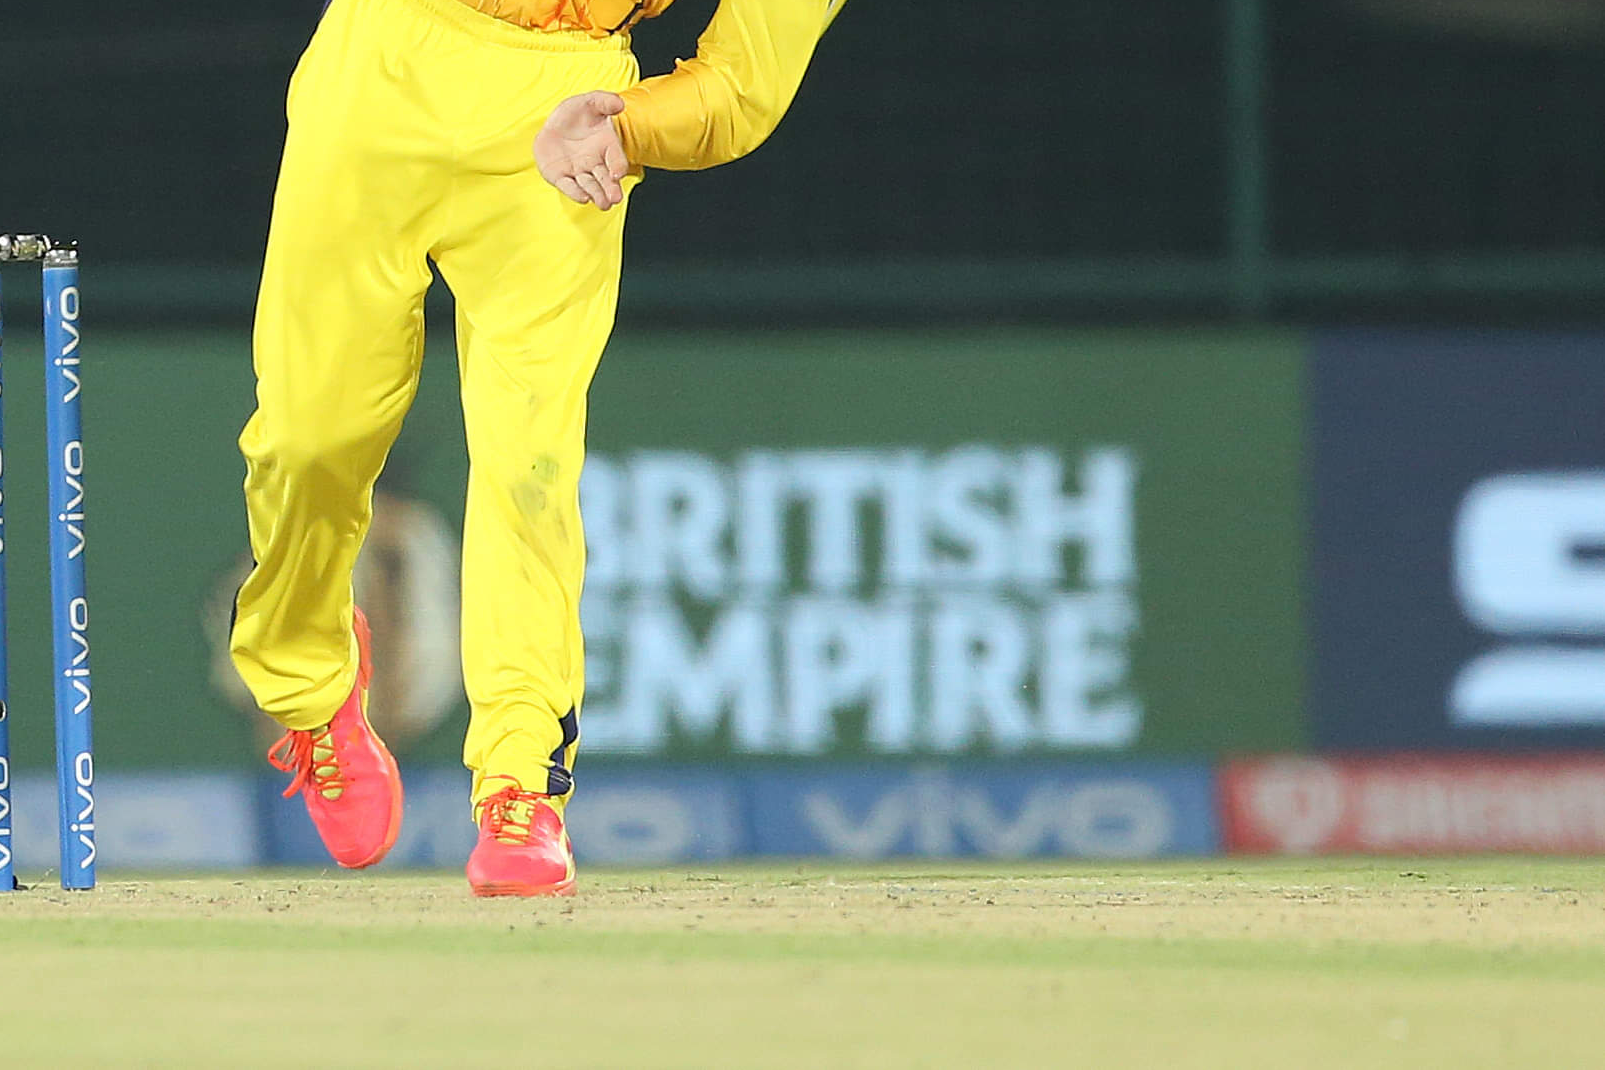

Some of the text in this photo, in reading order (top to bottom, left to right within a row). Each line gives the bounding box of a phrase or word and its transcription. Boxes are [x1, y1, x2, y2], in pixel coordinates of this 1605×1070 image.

[54, 286, 81, 405] vivo
[59, 441, 85, 561] vivo
[65, 597, 92, 716] vivo
[71, 752, 96, 870] vivo
[803, 770, 1175, 860] vivo
